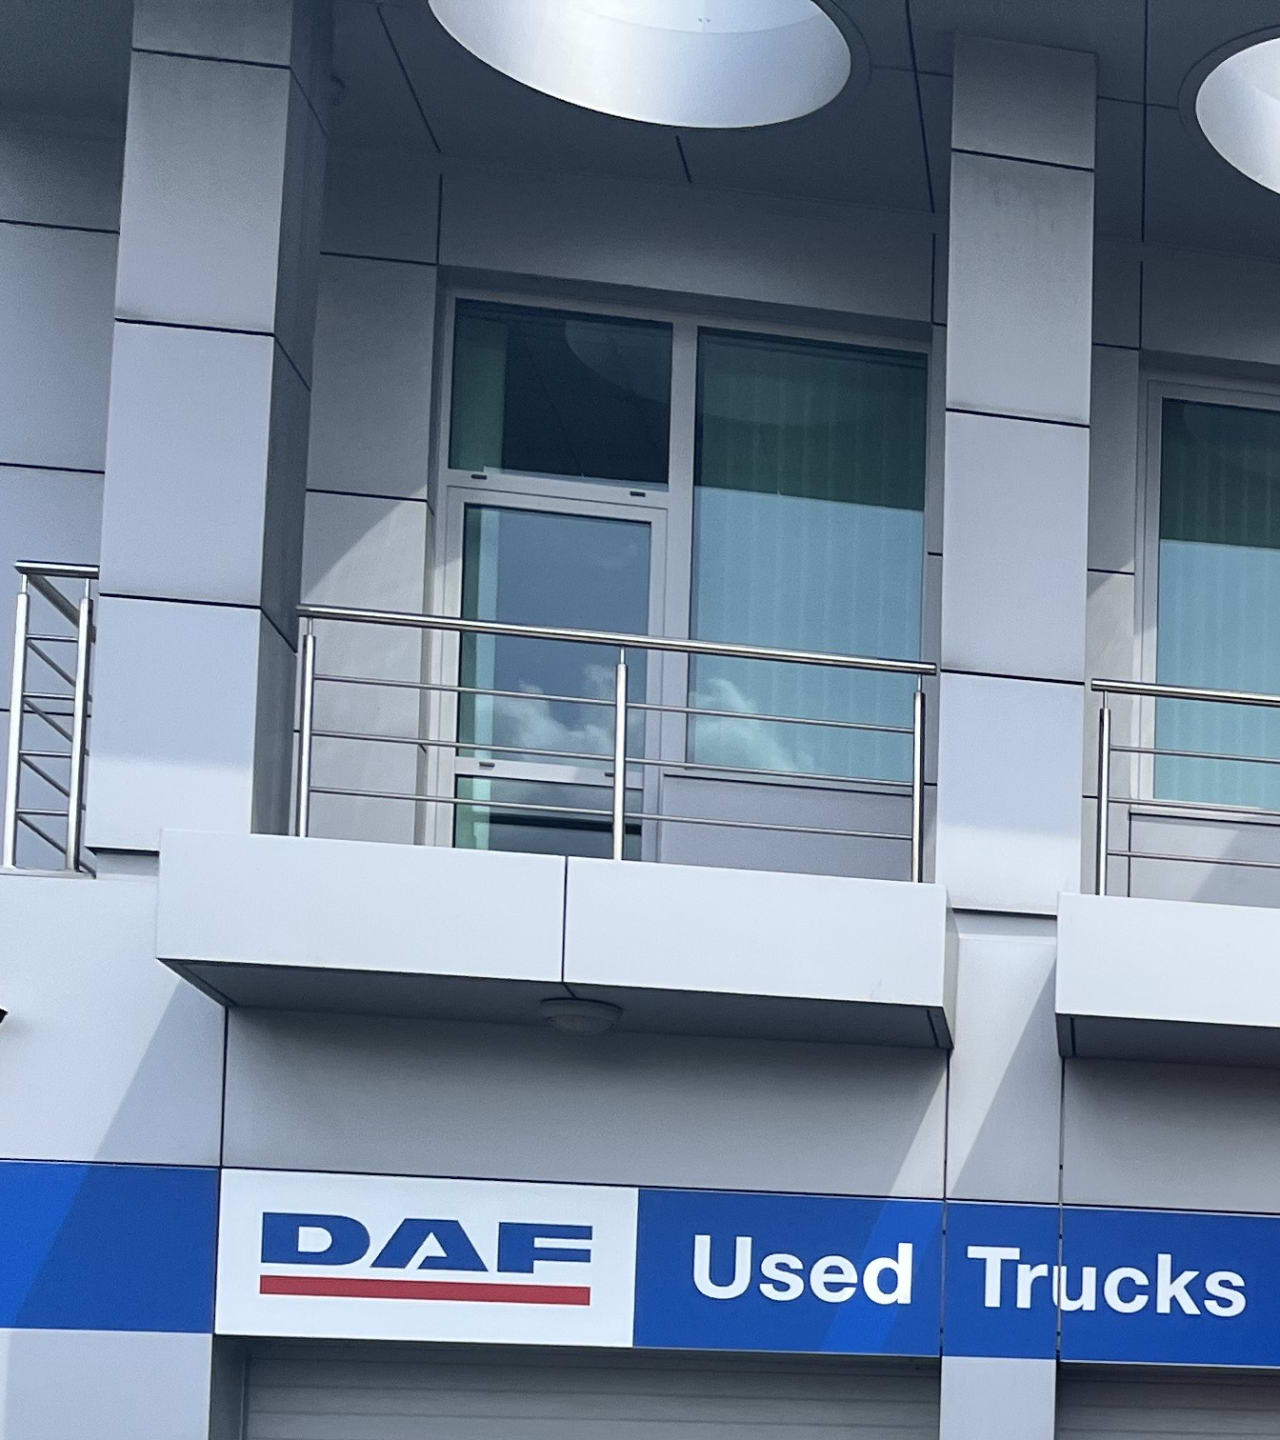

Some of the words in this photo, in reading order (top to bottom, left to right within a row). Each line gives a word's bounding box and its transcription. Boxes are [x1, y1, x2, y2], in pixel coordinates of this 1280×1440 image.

[260, 1211, 593, 1274] DAF
[692, 1234, 914, 1305] Used
[966, 1245, 1247, 1318] Trucks
